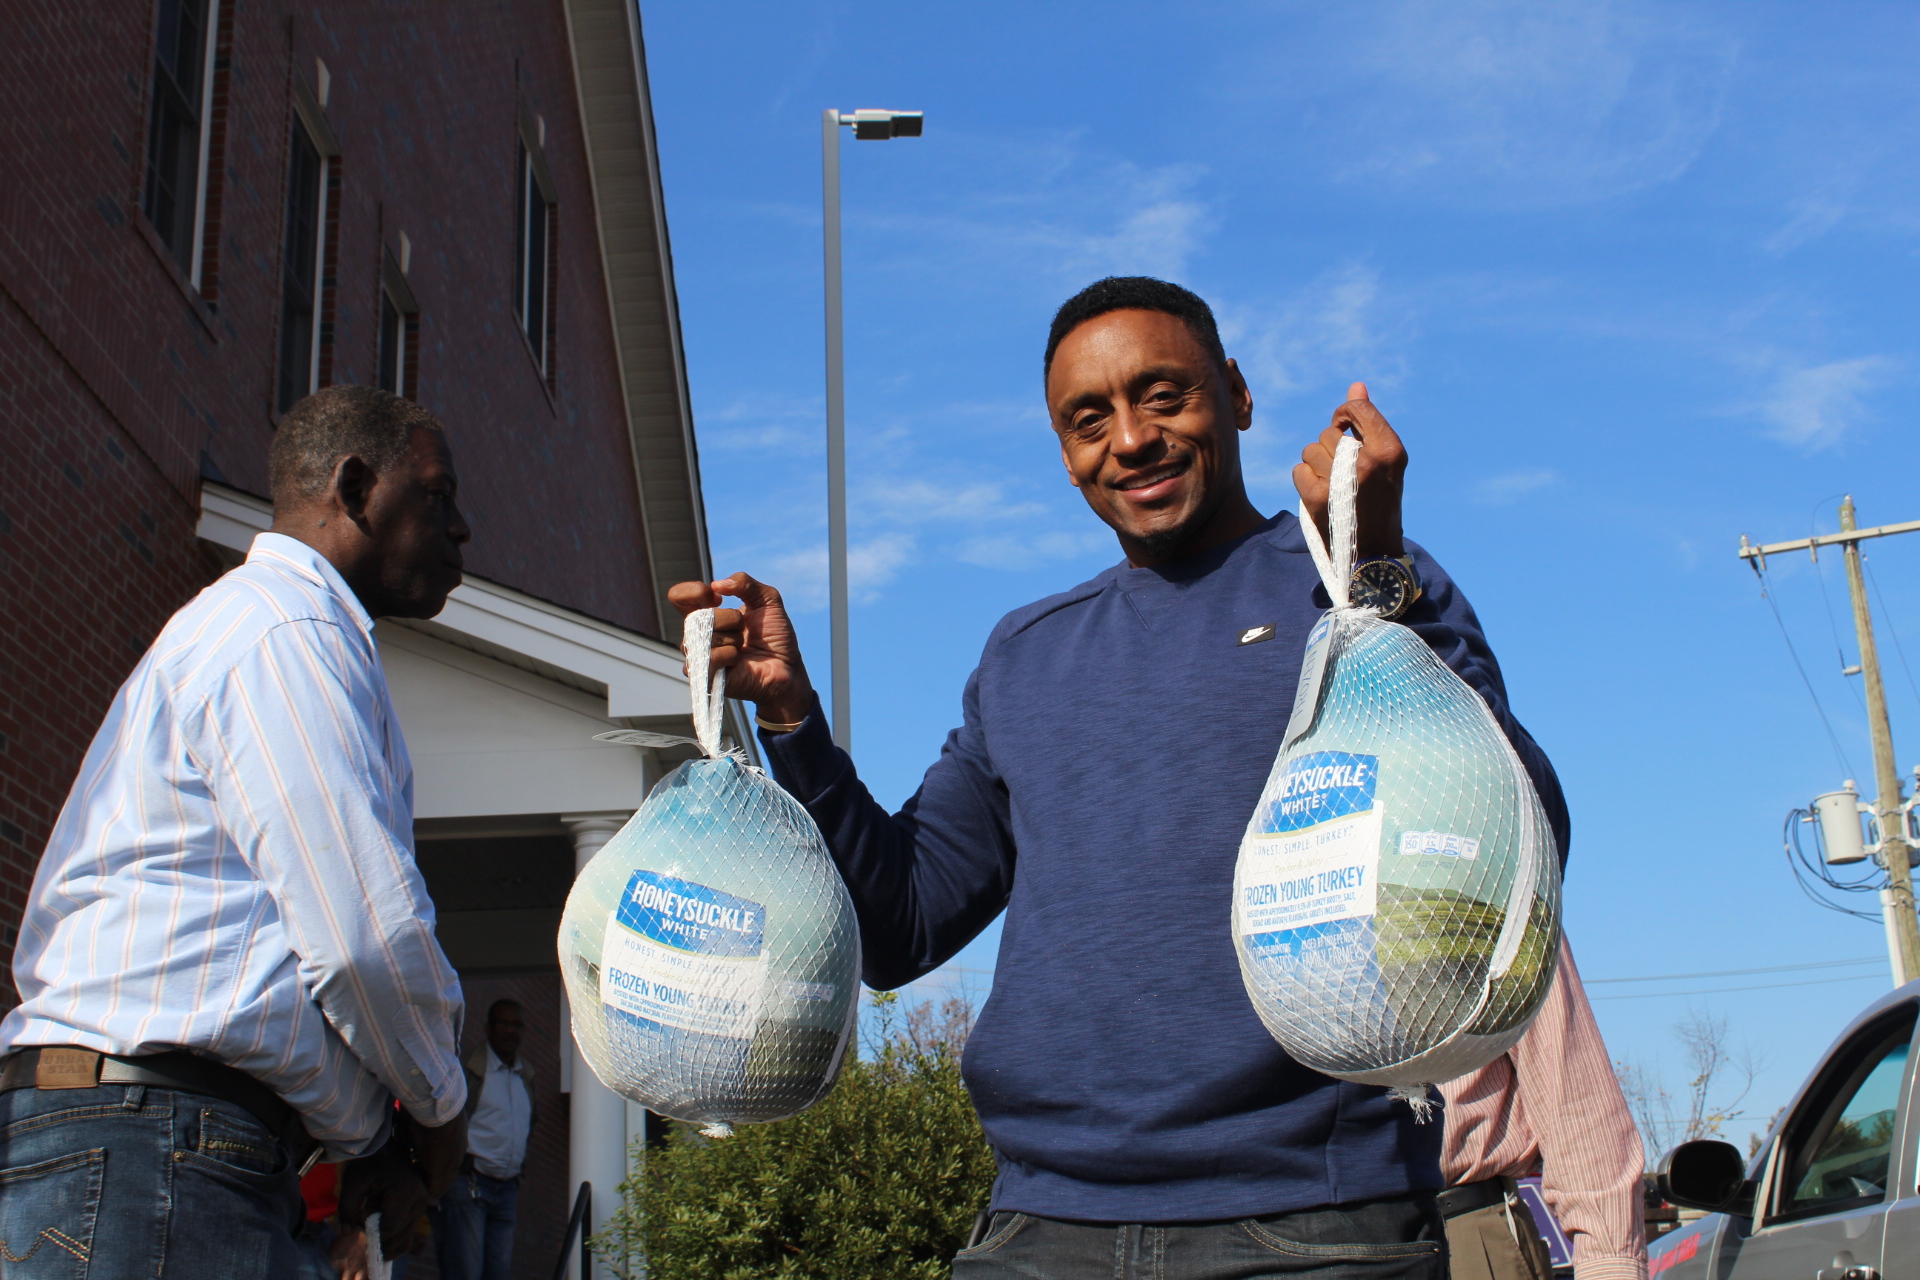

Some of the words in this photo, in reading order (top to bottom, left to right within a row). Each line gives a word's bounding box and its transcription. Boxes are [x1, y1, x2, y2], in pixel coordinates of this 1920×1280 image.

[1294, 650, 1317, 719] FROZEN
[1269, 764, 1367, 803] NEYSUCKLE
[1280, 875, 1315, 902] YOUNG
[1317, 865, 1366, 894] TURKEY
[632, 881, 755, 934] HONEYSUCKLE
[662, 953, 695, 970] SIMPLE.
[608, 967, 650, 997] FROZEN
[653, 981, 695, 1010] YOUNG
[42, 1055, 96, 1064] URBAN
[48, 1064, 88, 1074] STAR
